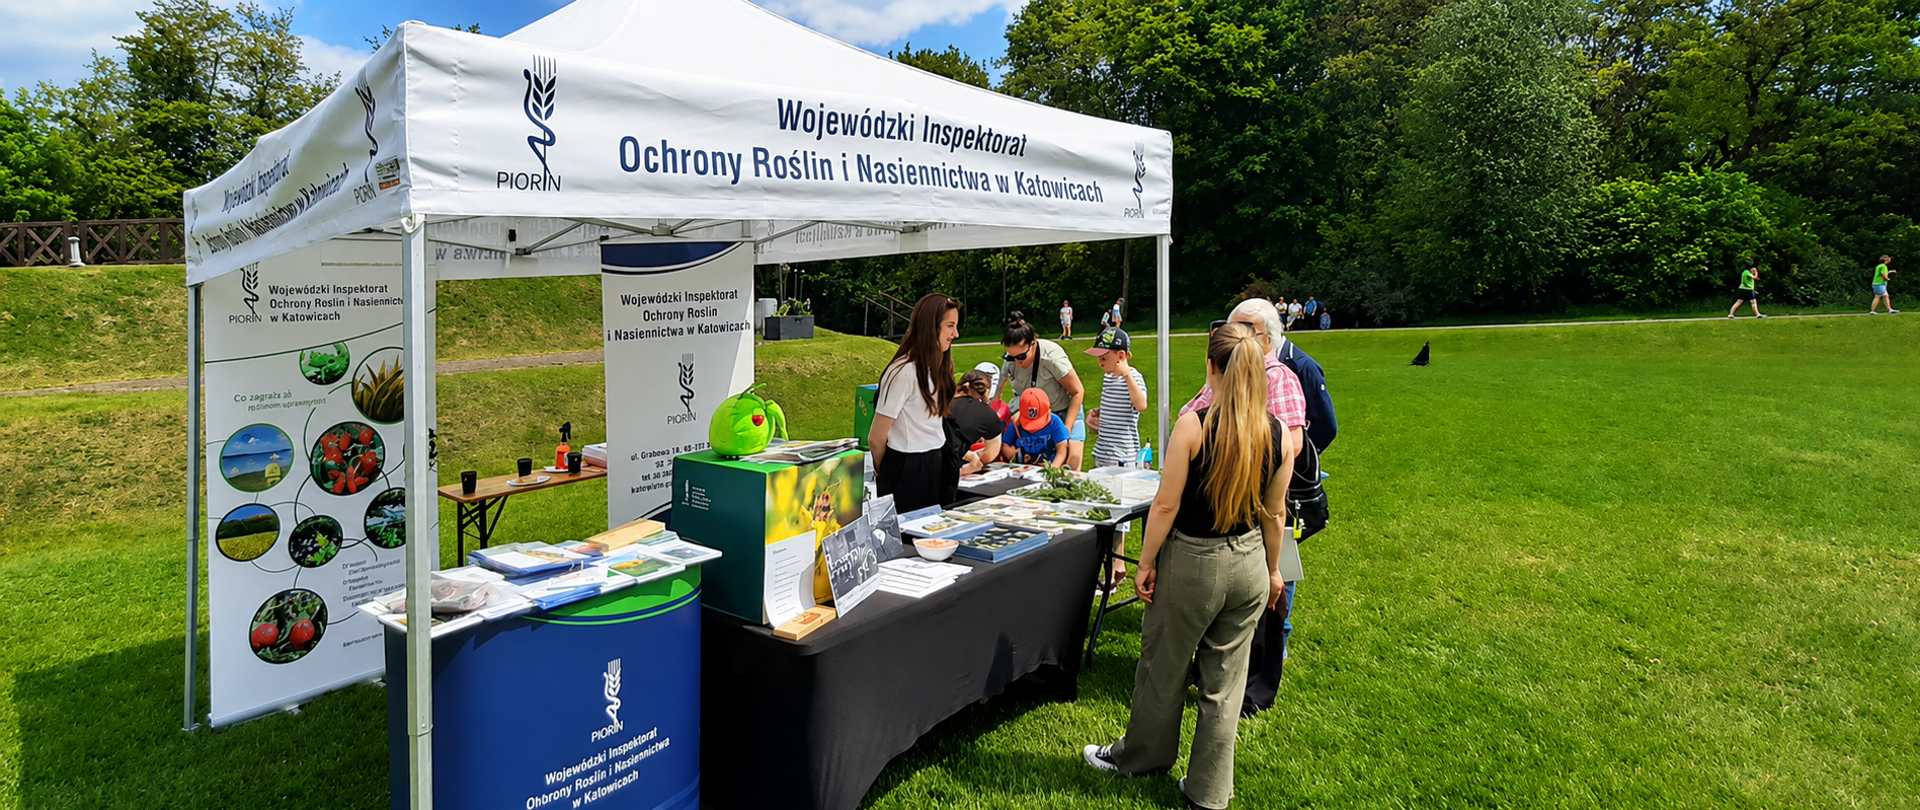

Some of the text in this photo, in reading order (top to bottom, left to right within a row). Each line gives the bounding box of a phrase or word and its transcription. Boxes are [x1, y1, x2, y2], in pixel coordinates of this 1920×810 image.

[777, 97, 1028, 157] Wojewódzki Inspektorat
[619, 135, 1104, 203] Ochrony Roślin i Nasiennictwa w Katowicach
[497, 171, 561, 192] PIORIN
[268, 285, 388, 296] Wojewódzki Inspektorat
[621, 289, 738, 306] Wojewódzki Inspektorat
[270, 299, 311, 310] Ochrony
[643, 308, 684, 322] Ochrony
[229, 315, 262, 324] PIORIN
[283, 311, 341, 322] Katowicach
[608, 319, 751, 341] i Nasiennictwa w Katowicach
[667, 412, 697, 425] PIORIN
[591, 720, 624, 743] PIORIN
[545, 727, 658, 785] Wojewódzki Inspektorat
[609, 764, 613, 776] i
[614, 737, 670, 774] Nasiennictwa
[572, 769, 639, 809] w Katowicach
